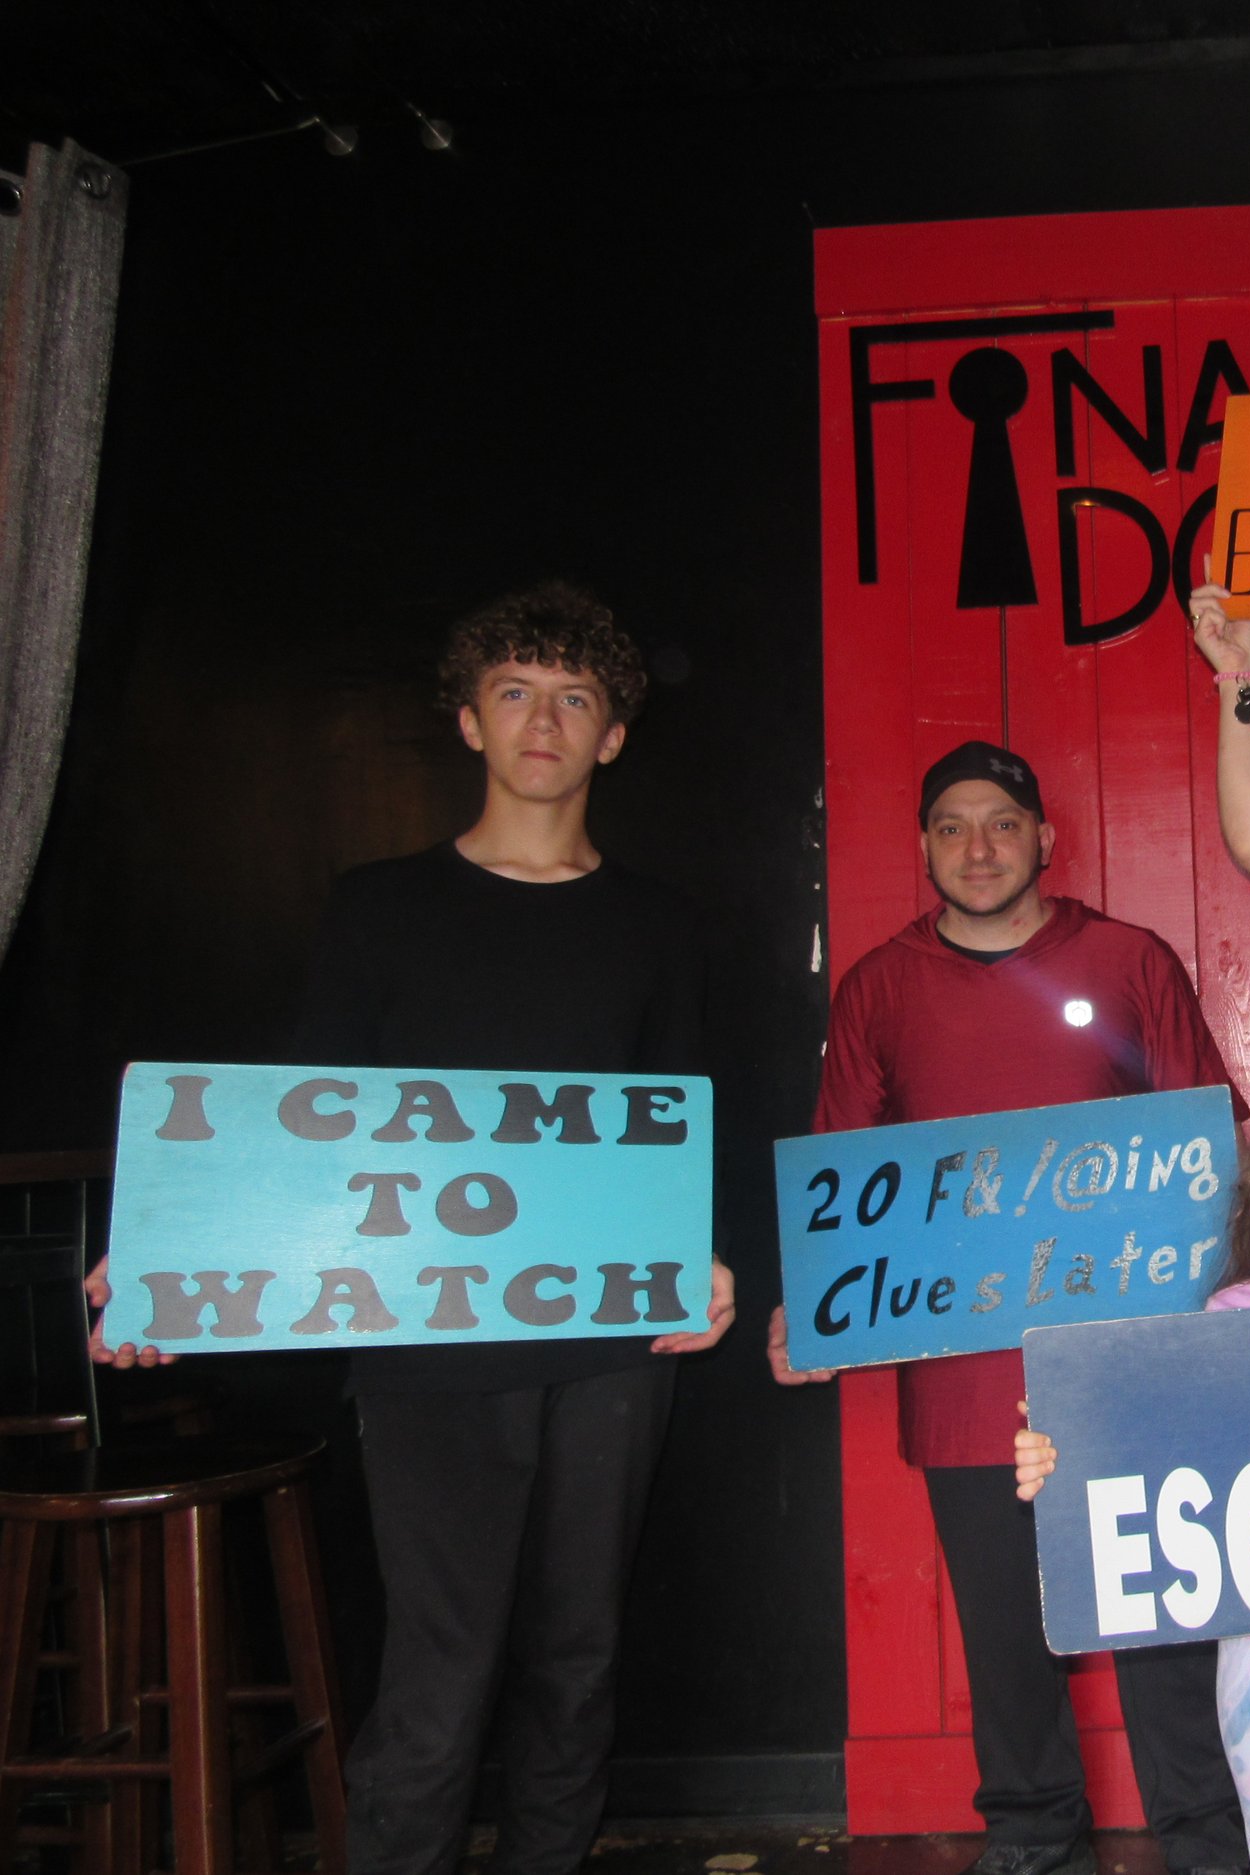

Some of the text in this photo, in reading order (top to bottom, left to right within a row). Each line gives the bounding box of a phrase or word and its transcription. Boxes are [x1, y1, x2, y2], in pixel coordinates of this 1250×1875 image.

[155, 1075, 689, 1147] I CAME
[347, 1172, 518, 1237] TO
[806, 1160, 902, 1233] 20
[138, 1262, 691, 1341] WATCH
[813, 1231, 1218, 1337] Clues Later
